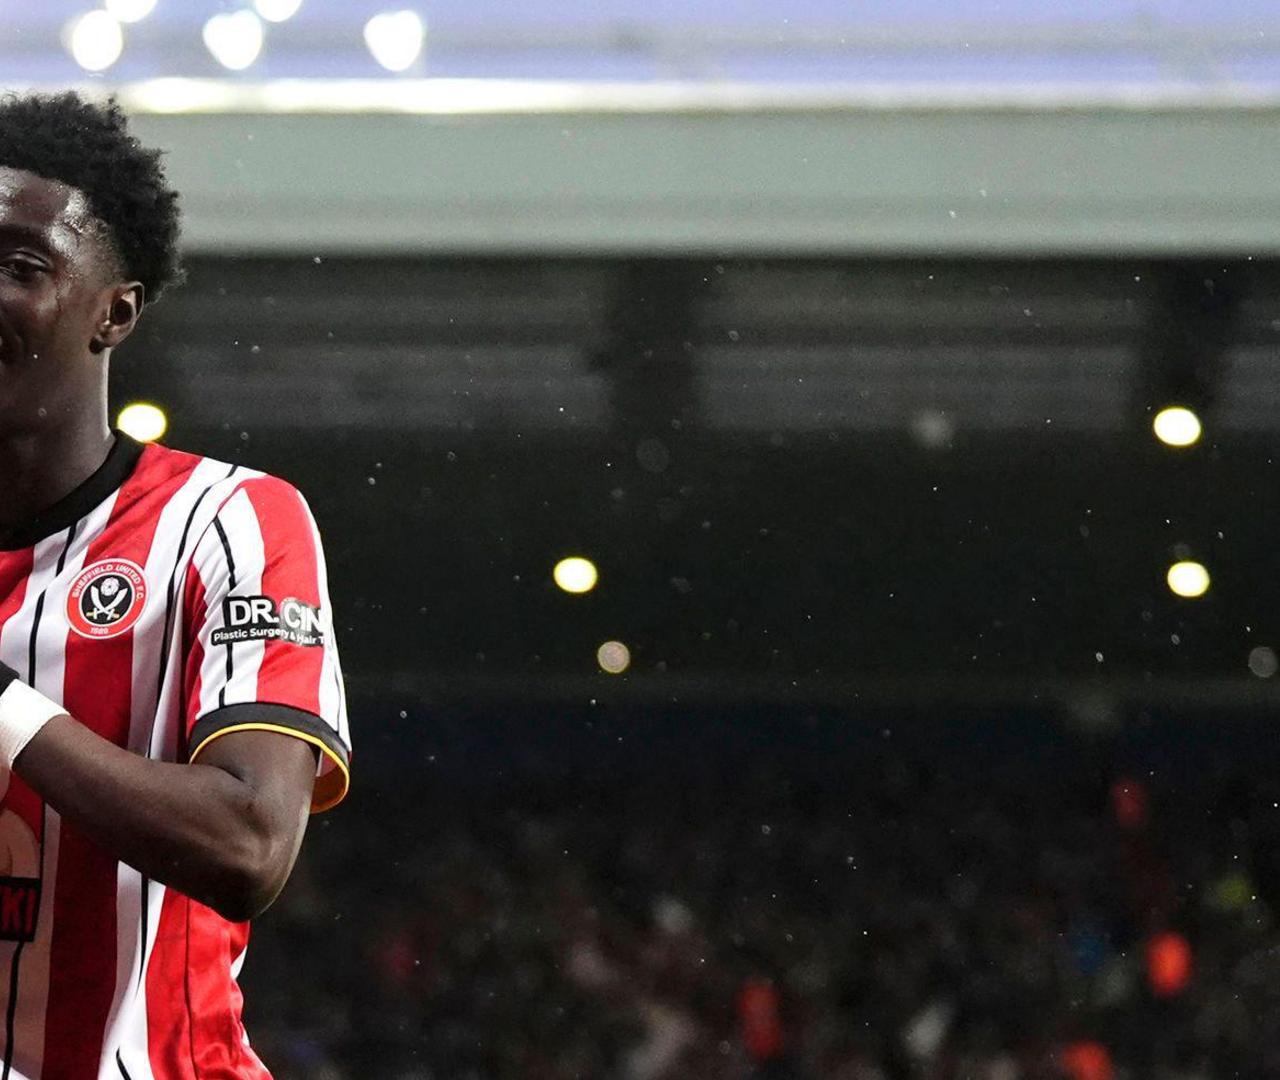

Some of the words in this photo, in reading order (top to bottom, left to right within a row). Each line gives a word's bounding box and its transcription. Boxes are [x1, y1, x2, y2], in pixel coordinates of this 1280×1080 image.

[229, 598, 280, 626] DR.
[213, 628, 248, 642] Plastic
[249, 627, 289, 640] Surgery
[296, 633, 316, 645] Hair
